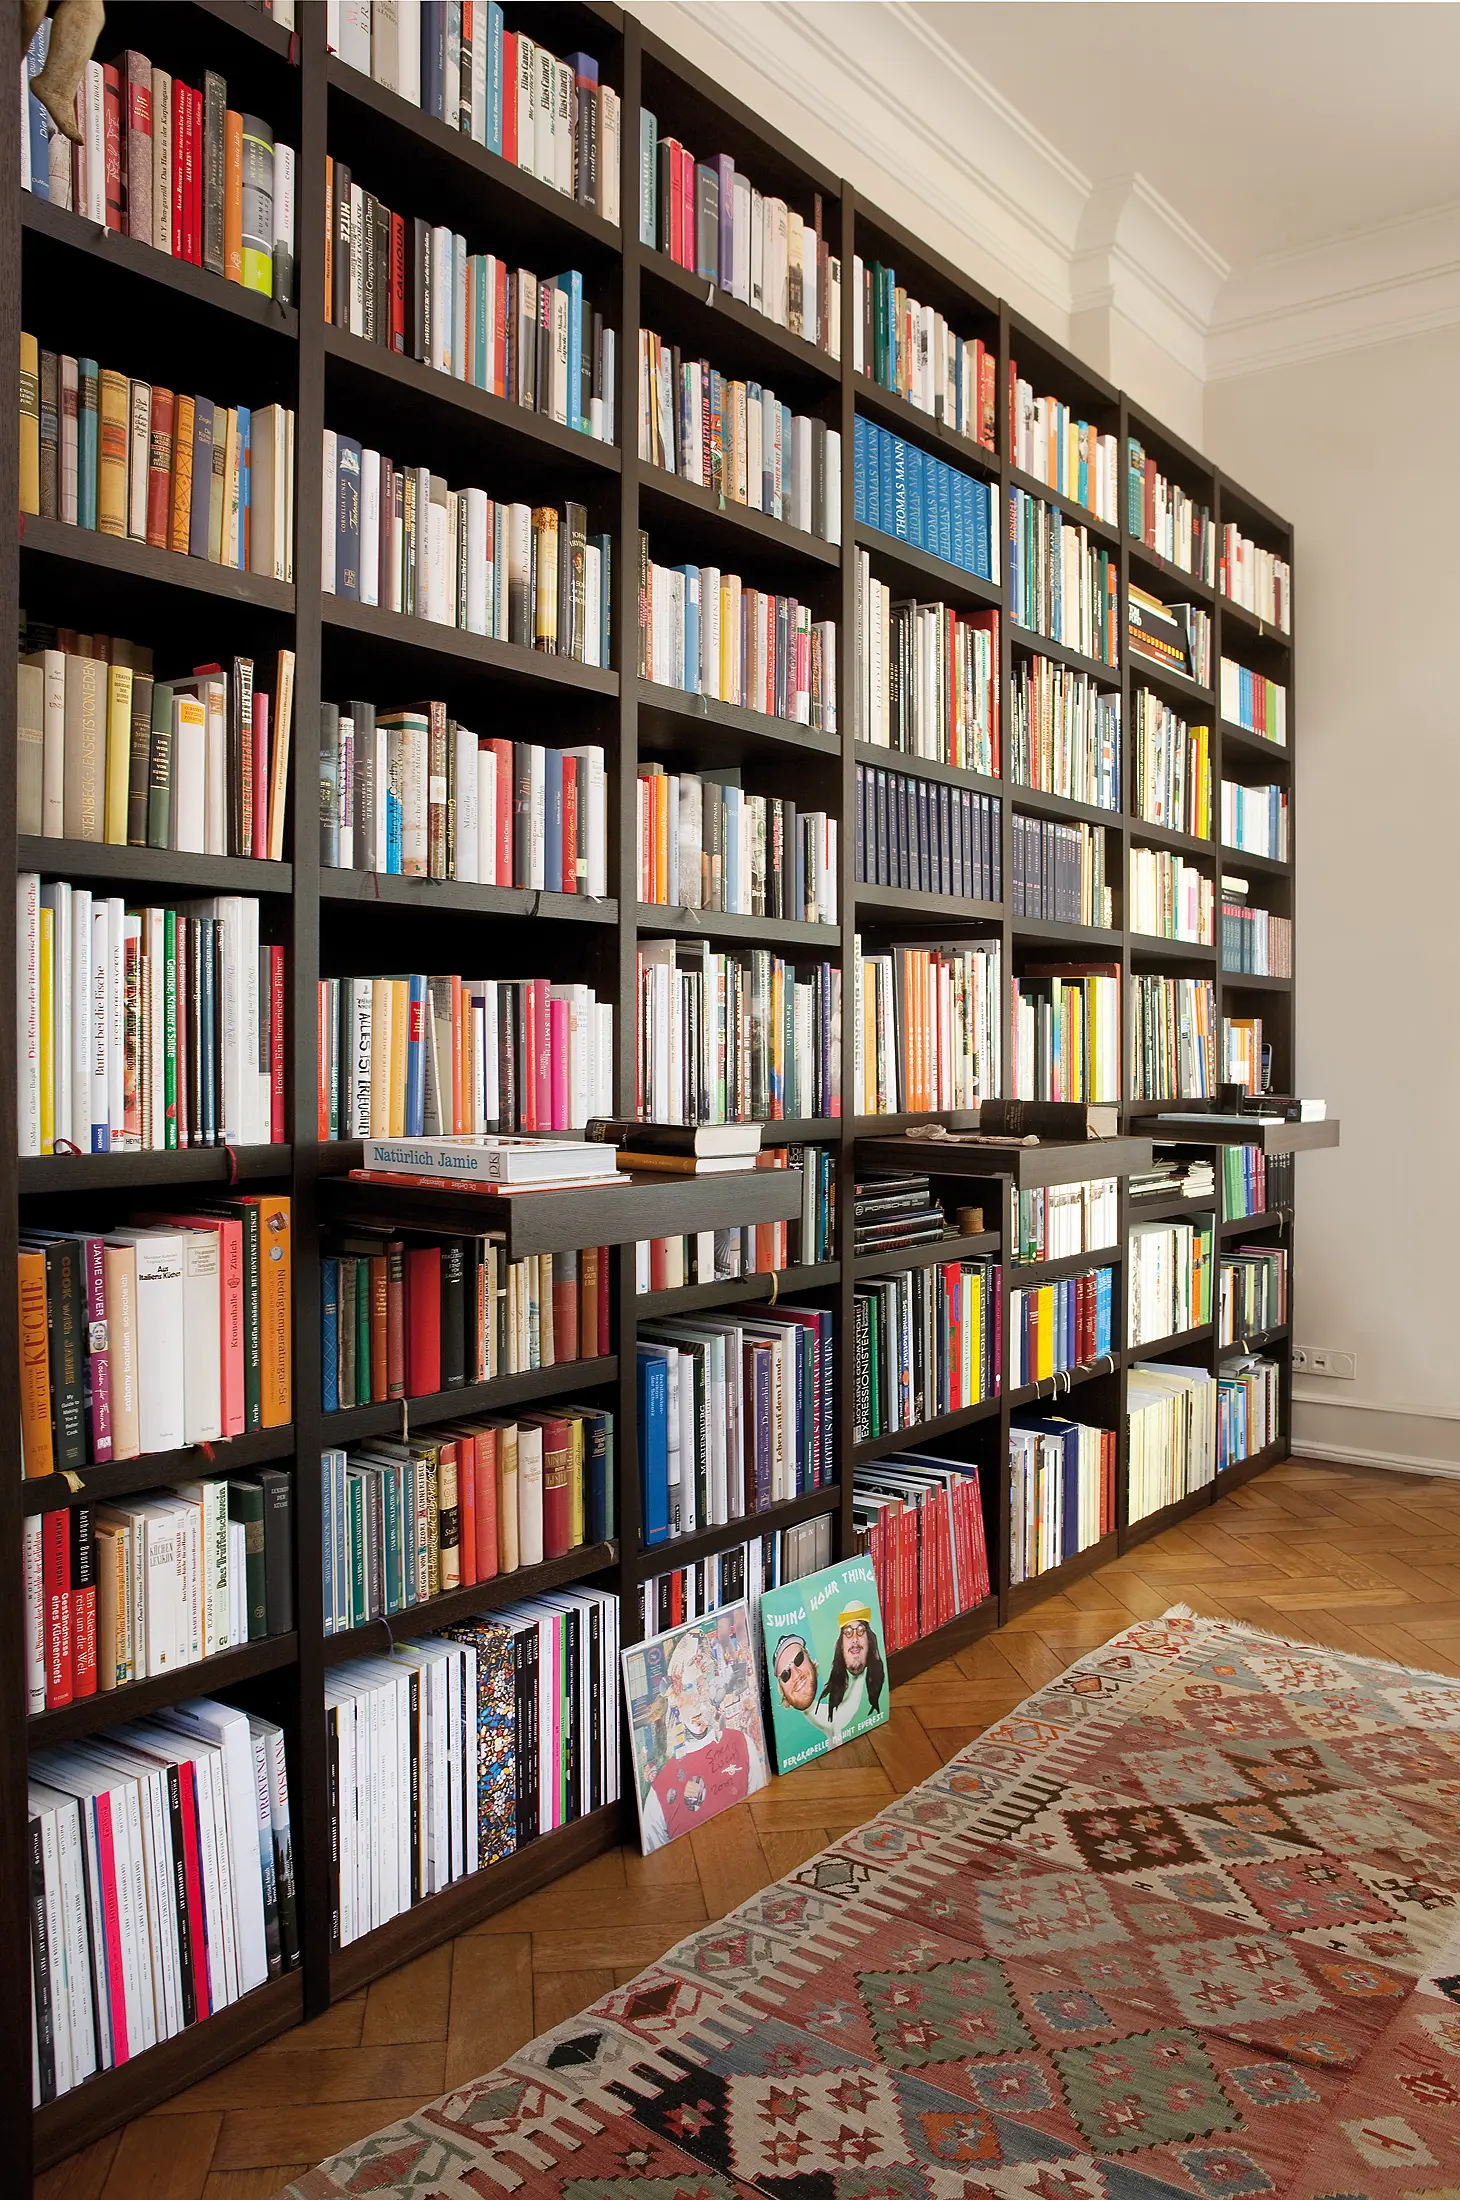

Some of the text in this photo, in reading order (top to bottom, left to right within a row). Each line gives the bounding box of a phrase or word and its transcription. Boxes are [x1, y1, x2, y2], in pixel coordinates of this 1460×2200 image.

[520, 41, 529, 91] Elias Canetti
[540, 55, 549, 111] Elias Canetti
[557, 69, 568, 120] Elias Canetti
[159, 148, 168, 165] Haus
[159, 167, 168, 180] Das
[340, 200, 351, 244] HITZE
[364, 197, 374, 223] Dame
[396, 222, 404, 301] CALHOUN
[702, 397, 711, 444] ATTRACTION
[702, 446, 711, 455] OF
[773, 414, 782, 500] ZIMMER MIT AUSSICHT
[868, 427, 879, 523] THOMAS MANN
[702, 475, 711, 488] THE
[895, 441, 906, 535] THOMAS MANN
[927, 458, 937, 550] THOMAS MANN
[976, 485, 986, 572] THOMAS MANN
[712, 603, 720, 647] STEPHEN
[241, 664, 252, 724] BILL CARTER
[82, 660, 97, 837] STEINBECK JENSEITS VON EDEN
[388, 759, 399, 844] Mary McCarthy
[26, 882, 37, 1058] Die Kultur der italienischen Küche
[164, 958, 177, 994] Gemüse,
[94, 965, 105, 1077] Butter bei die Fische
[165, 994, 177, 1025] Kräuter
[273, 956, 284, 1095] Hotels. Ein literarischer Führer
[166, 1033, 177, 1058] Salate
[357, 1013, 372, 1136] ALLES IST ERLEUCHTET
[374, 1147, 478, 1170] Natürlich Jamie
[489, 1152, 501, 1178] DK
[250, 1210, 258, 1232] TISCH
[250, 1233, 258, 1242] ZU
[61, 1255, 71, 1299] COOK
[92, 1243, 103, 1276] JAMIE
[250, 1243, 258, 1274] FONTANE
[250, 1275, 258, 1287] BEI
[94, 1278, 105, 1317] OLIVER
[228, 1240, 239, 1348] Kronenhalle Zürich
[21, 1276, 47, 1420] DIE GUTE KÜCHE
[250, 1327, 259, 1348] Gräfin
[250, 1350, 259, 1367] Sybil
[96, 1359, 109, 1387] Kochen
[120, 1331, 134, 1412] anthony bourdain
[860, 1326, 870, 1438] EXPRESSIONISTEN
[252, 1403, 260, 1423] Arche
[761, 1371, 770, 1425] Deutschland
[774, 1357, 783, 1464] Leben auf dem Lande
[55, 1517, 63, 1549] ANTHONY
[78, 1510, 90, 1583] Anthony Bourdain
[416, 1464, 428, 1601] GREGOR VON REZZORI MÄNNERFIBEL
[766, 1607, 807, 1627] SWING
[842, 1568, 876, 1584] THING
[51, 1592, 69, 1684] Geständnisse eines Küchenchefs
[76, 1591, 96, 1675] Ein Küchenchef reist um die Welt
[857, 1711, 885, 1731] EVEREST
[255, 1744, 271, 1821] PROVENCE
[275, 1738, 289, 1807] TOSKANA
[33, 1833, 41, 1865] PHILLIPS
